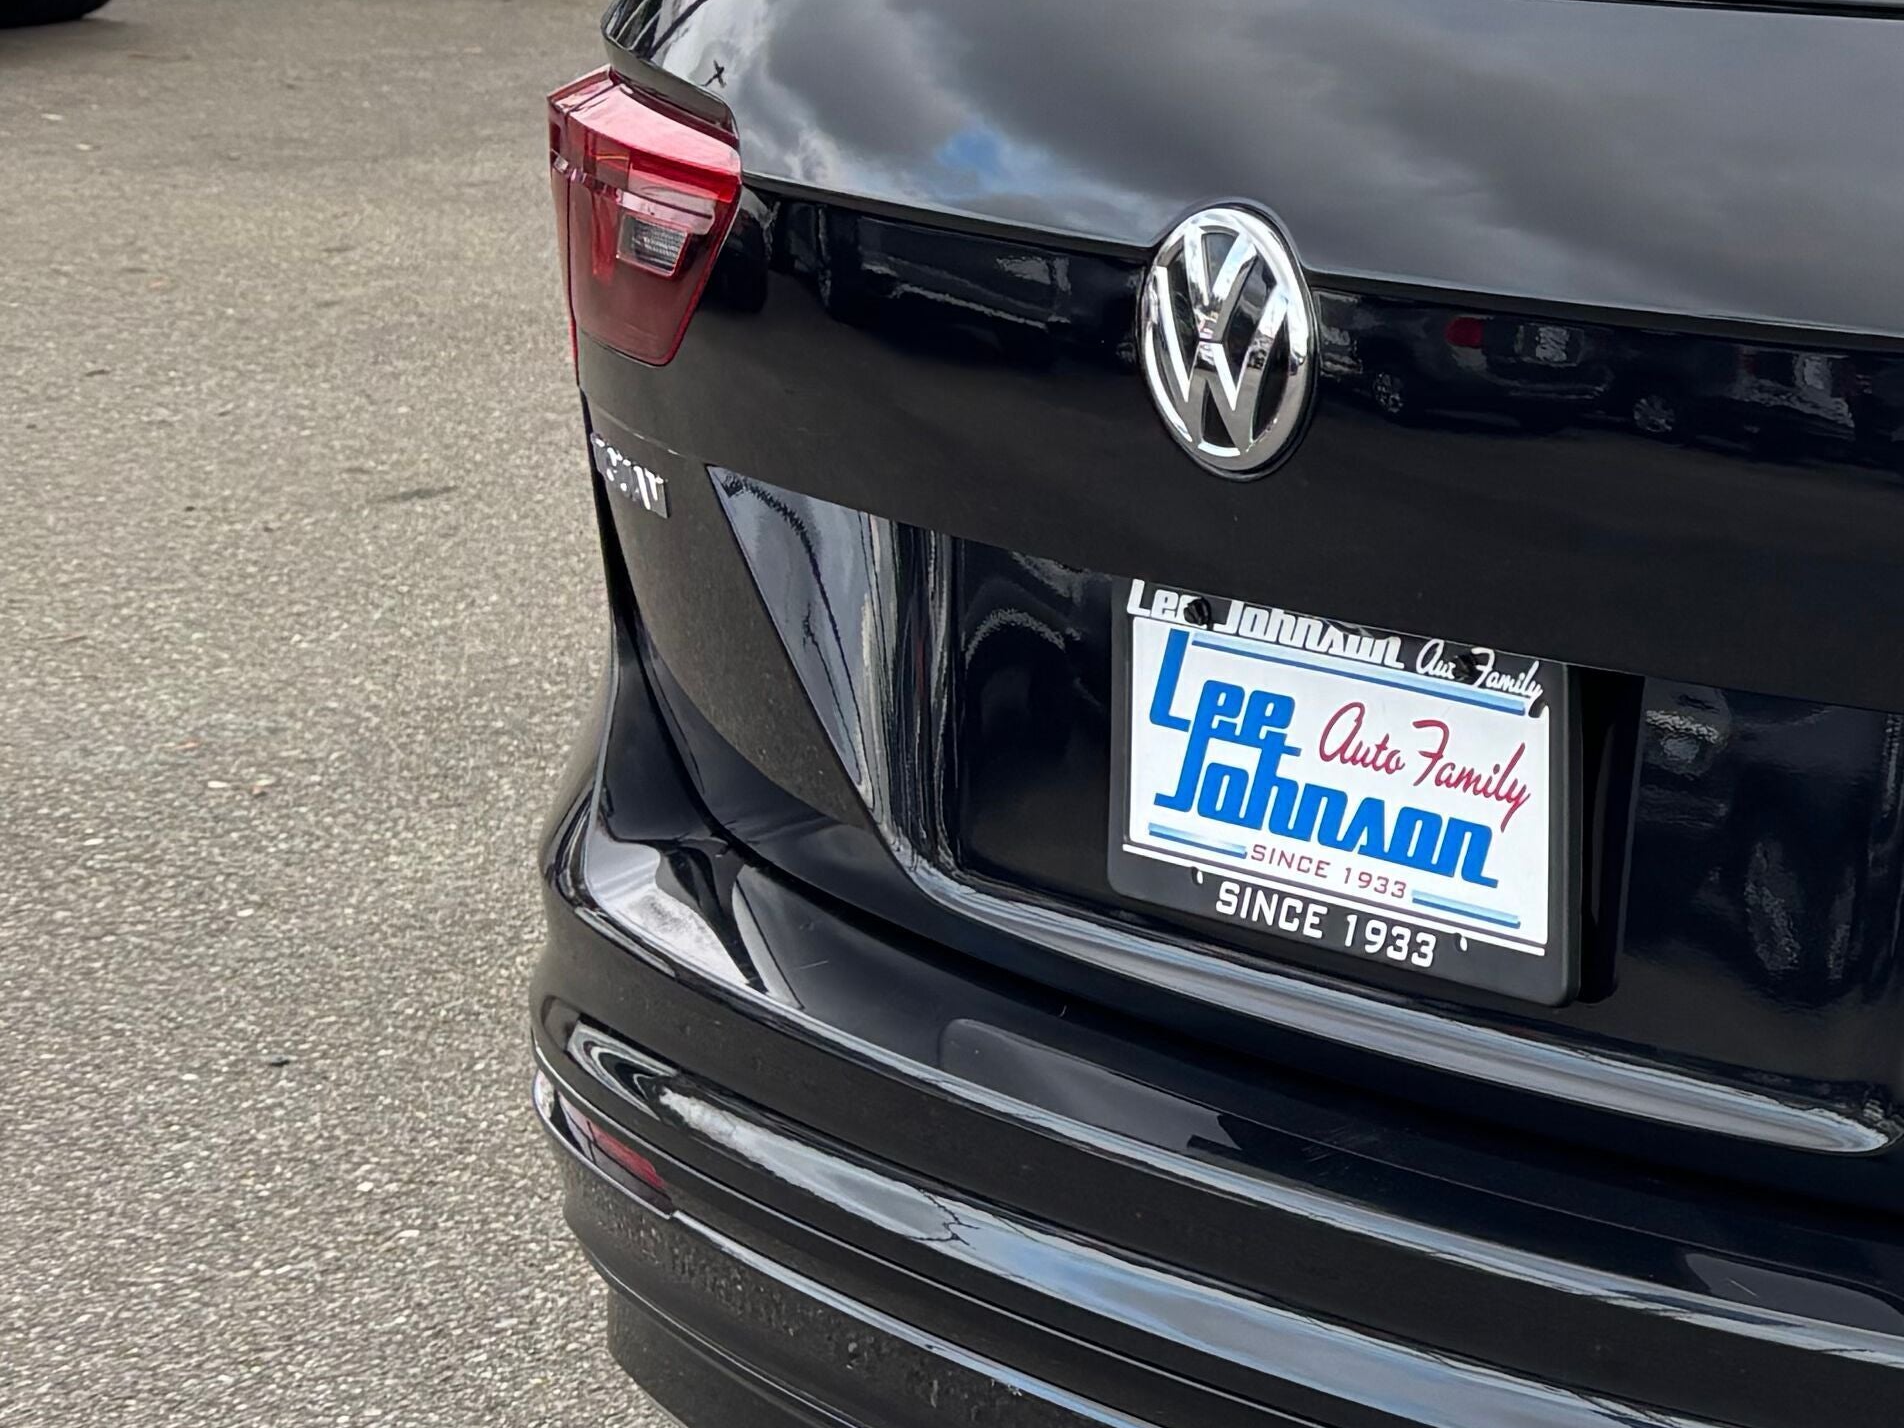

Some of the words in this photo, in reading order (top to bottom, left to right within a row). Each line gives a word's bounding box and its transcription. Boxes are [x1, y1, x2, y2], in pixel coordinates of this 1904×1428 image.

[1127, 578, 1207, 630] Lee
[1213, 600, 1404, 669] Johnson
[1416, 638, 1459, 680] Aut
[1471, 646, 1544, 704] Family
[1149, 628, 1296, 741] Lee
[1154, 730, 1499, 889] Johnson
[1318, 701, 1406, 774] Auto
[1411, 719, 1532, 834] Family
[1215, 880, 1328, 940] SINCE
[1343, 914, 1437, 968] 1933
[1250, 844, 1331, 878] SINCE
[1343, 867, 1407, 899] 1933
